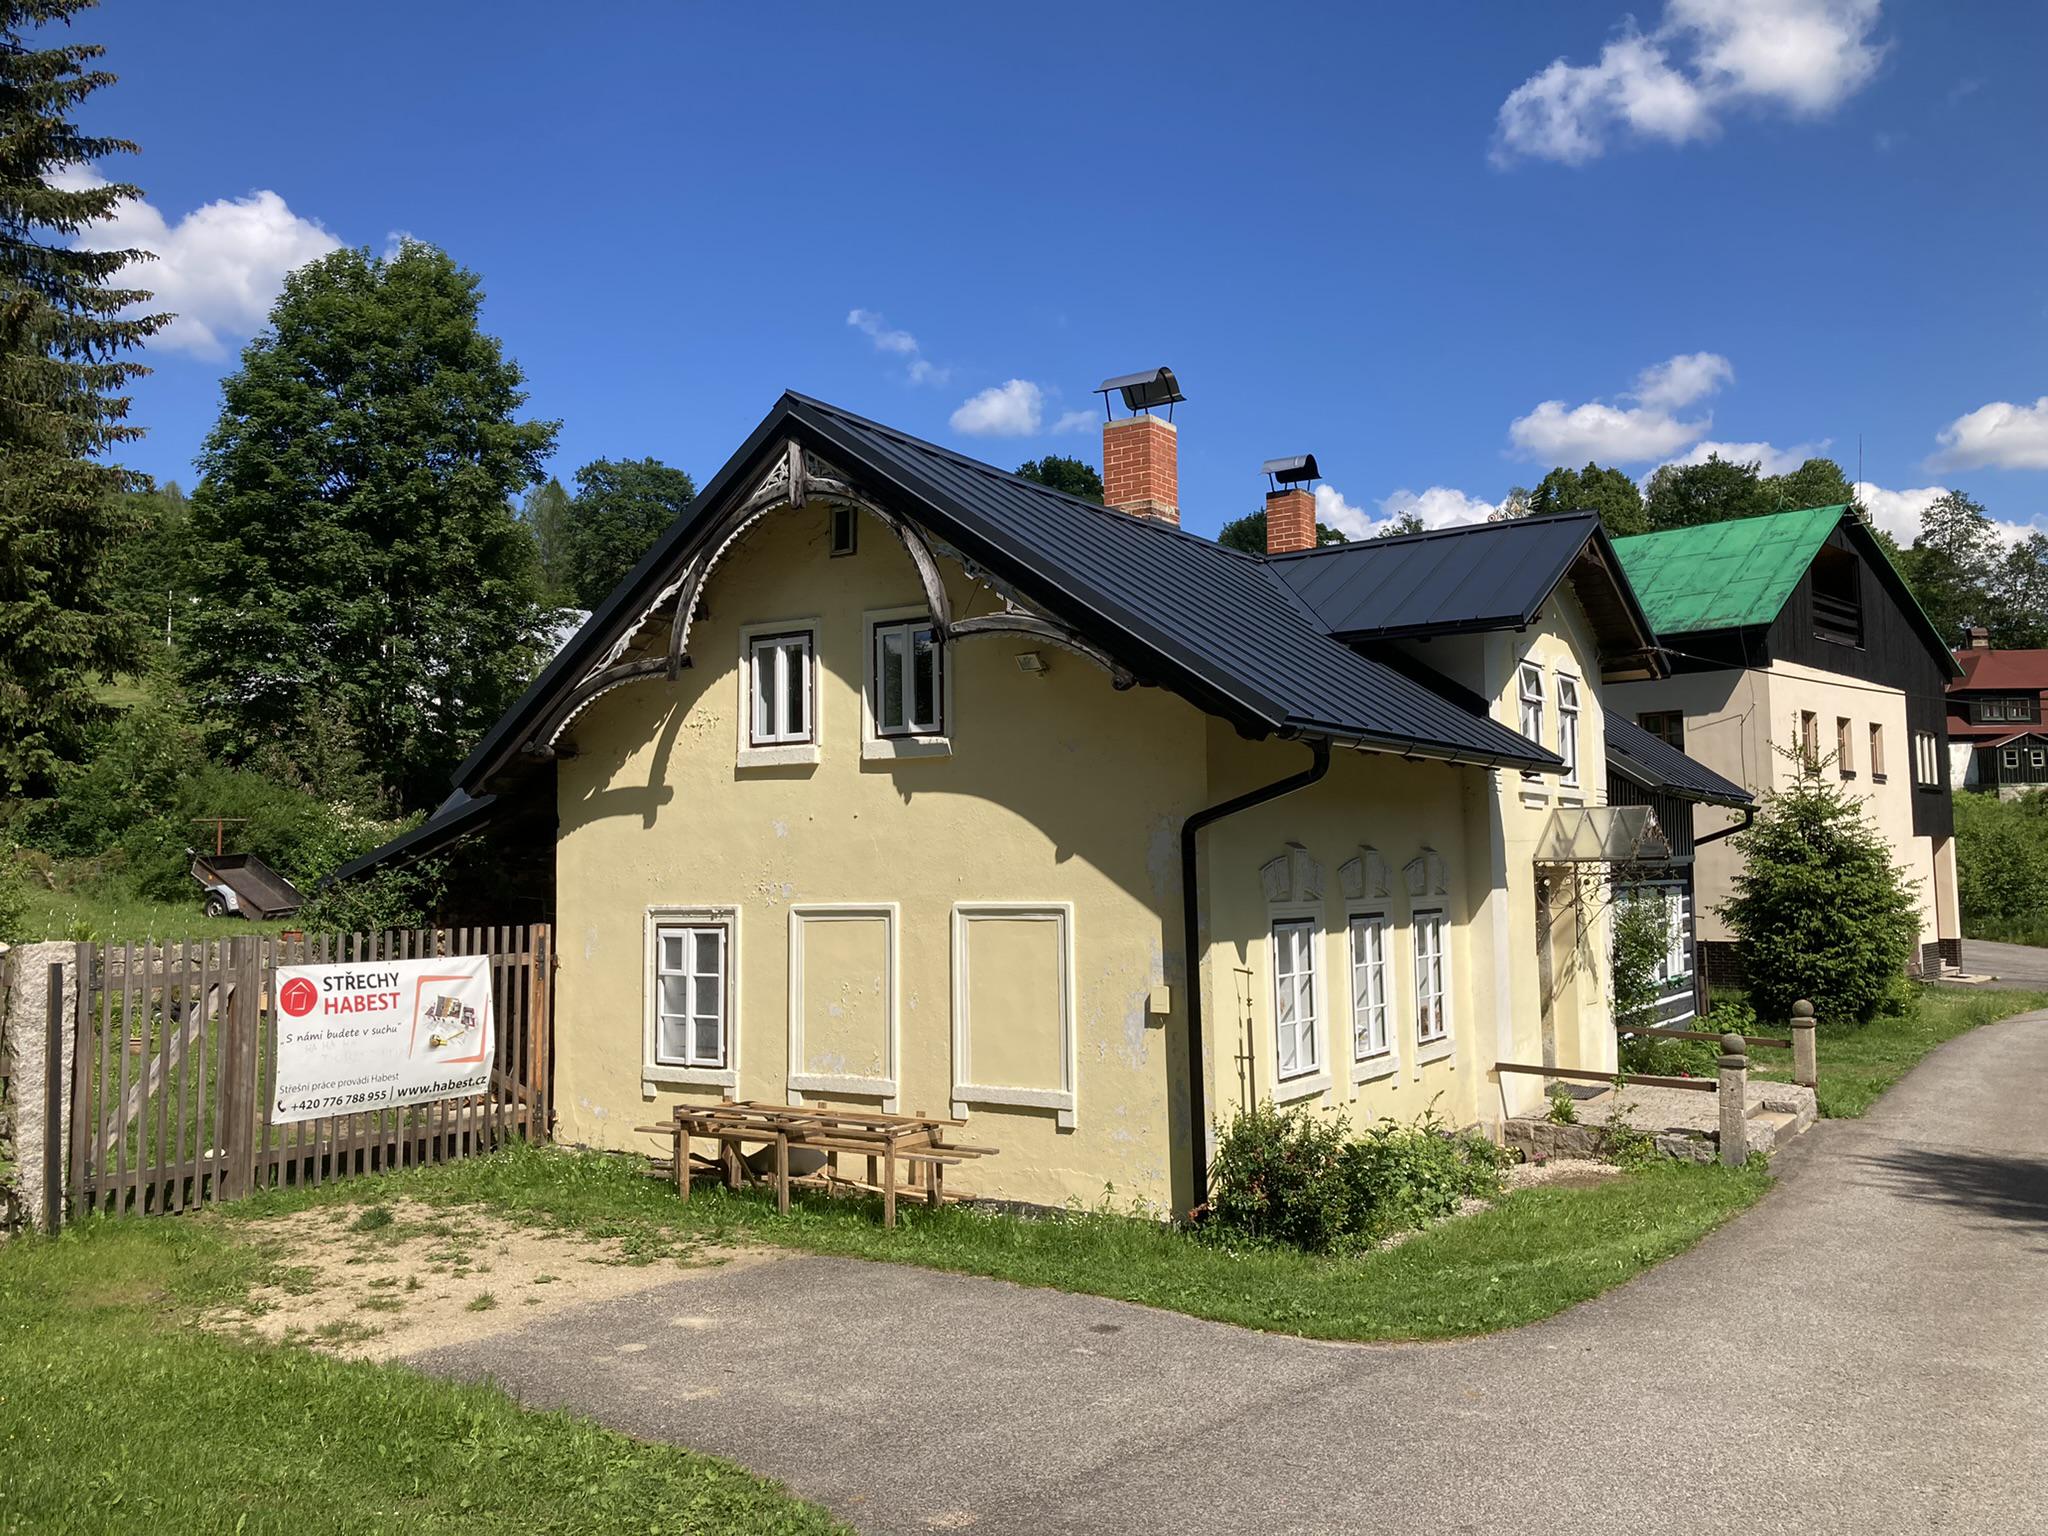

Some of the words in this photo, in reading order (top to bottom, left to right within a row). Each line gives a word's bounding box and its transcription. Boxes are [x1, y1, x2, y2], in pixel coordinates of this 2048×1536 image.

[323, 971, 399, 992] STŘECHY
[324, 992, 401, 1015] HABEST
[296, 1030, 323, 1042] námi
[326, 1028, 360, 1039] budete
[279, 1083, 310, 1095] Střešní
[311, 1080, 336, 1092] práce
[337, 1075, 370, 1088] provádí
[371, 1072, 400, 1084] Habest
[291, 1099, 320, 1112] +420
[322, 1096, 343, 1108] 776
[345, 1093, 365, 1105] 788
[367, 1090, 387, 1102] 955
[397, 1075, 488, 1097] www.habest.cz
